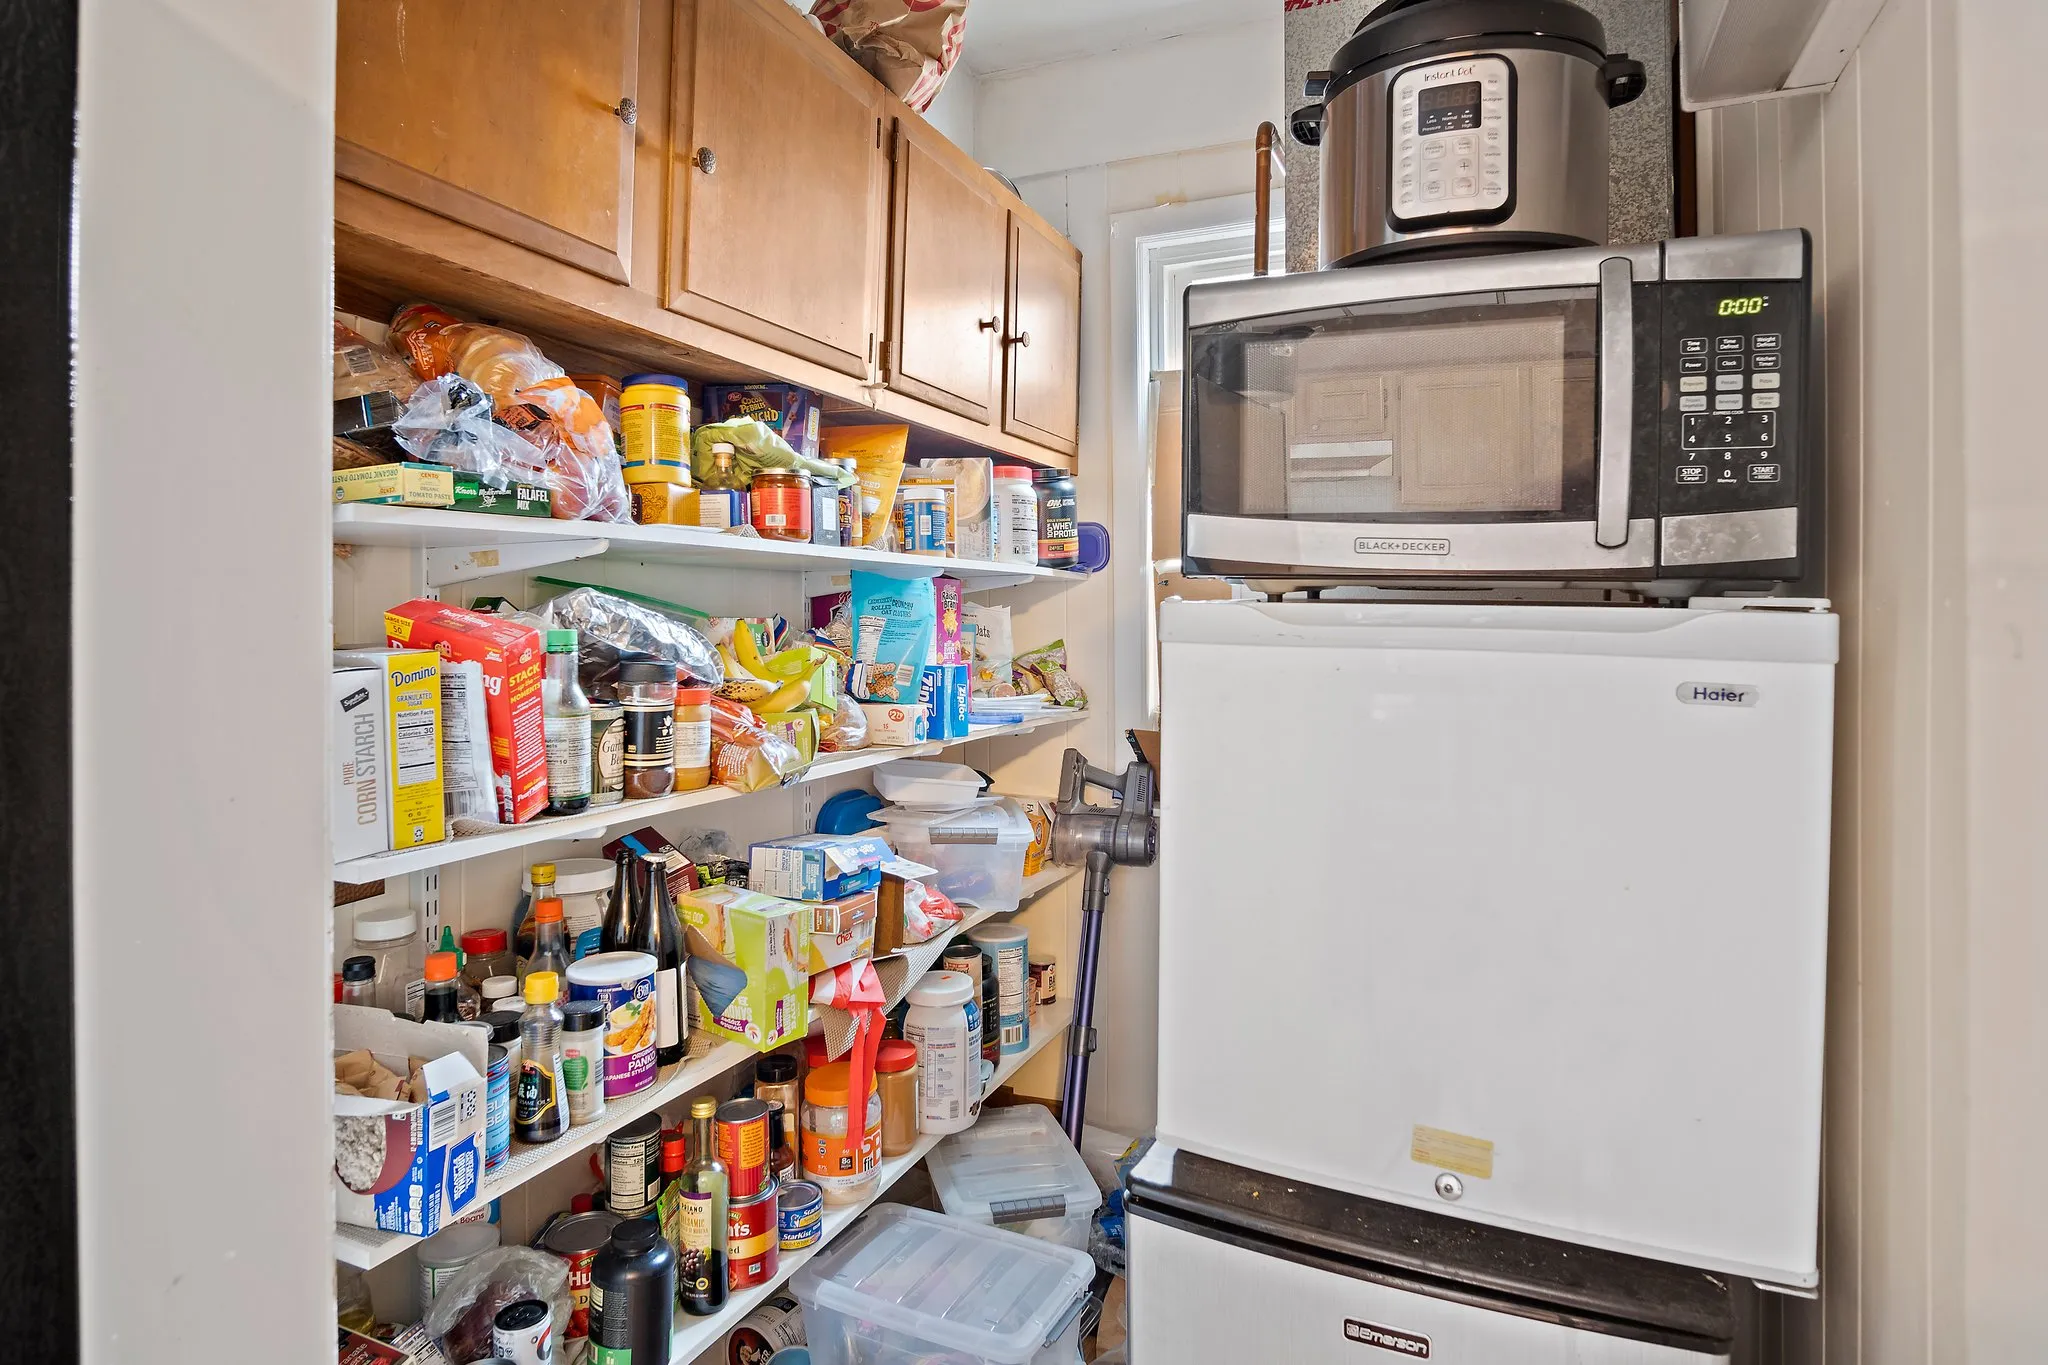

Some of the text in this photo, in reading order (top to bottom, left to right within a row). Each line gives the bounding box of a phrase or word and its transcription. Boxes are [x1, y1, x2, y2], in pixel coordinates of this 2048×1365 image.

[1424, 67, 1473, 82] Instant Pot
[1718, 297, 1762, 315] 0:00
[741, 396, 764, 405] COCOA
[739, 401, 767, 414] PEBBLES
[1690, 414, 1769, 426] 1 2 3
[1688, 432, 1769, 443] 4 5 6
[1688, 450, 1768, 461] 7 8 9
[349, 471, 374, 481] TOMATO
[373, 469, 399, 477] ORGANIC
[420, 472, 440, 480] CENTO
[1723, 469, 1731, 478] 0
[408, 491, 451, 501] TOMATO PASTE
[454, 486, 478, 496] Knorr
[516, 488, 549, 502] FALAFEL
[516, 500, 530, 511] MIX
[1053, 521, 1073, 530] WHEY
[1359, 541, 1446, 551] BLACK+DECKER
[942, 591, 957, 601] Raisin
[943, 600, 957, 610] Bran
[384, 615, 411, 627] LARGE SIZE
[393, 625, 402, 634] 50
[391, 666, 436, 687] Domino
[508, 662, 540, 687] STACK
[396, 692, 432, 702] GRANULATED
[510, 682, 541, 703] MOMENTS
[1693, 686, 1745, 703] Haier
[957, 684, 967, 721] Ziploc
[398, 726, 434, 738] Calories 30
[342, 761, 354, 786] PURE
[354, 712, 377, 826] CORN STARCH
[835, 930, 853, 946] Chex
[720, 1015, 742, 1026] Zipper
[720, 1020, 744, 1032] Double
[628, 1051, 656, 1071] PANKO
[631, 1065, 646, 1077] STYLE
[863, 1157, 873, 1172] fit
[460, 1212, 485, 1225] Beans
[783, 1230, 812, 1241] StarKist
[568, 1271, 591, 1286] Hu
[579, 1295, 588, 1305] D
[1359, 1323, 1428, 1355] Emerson
